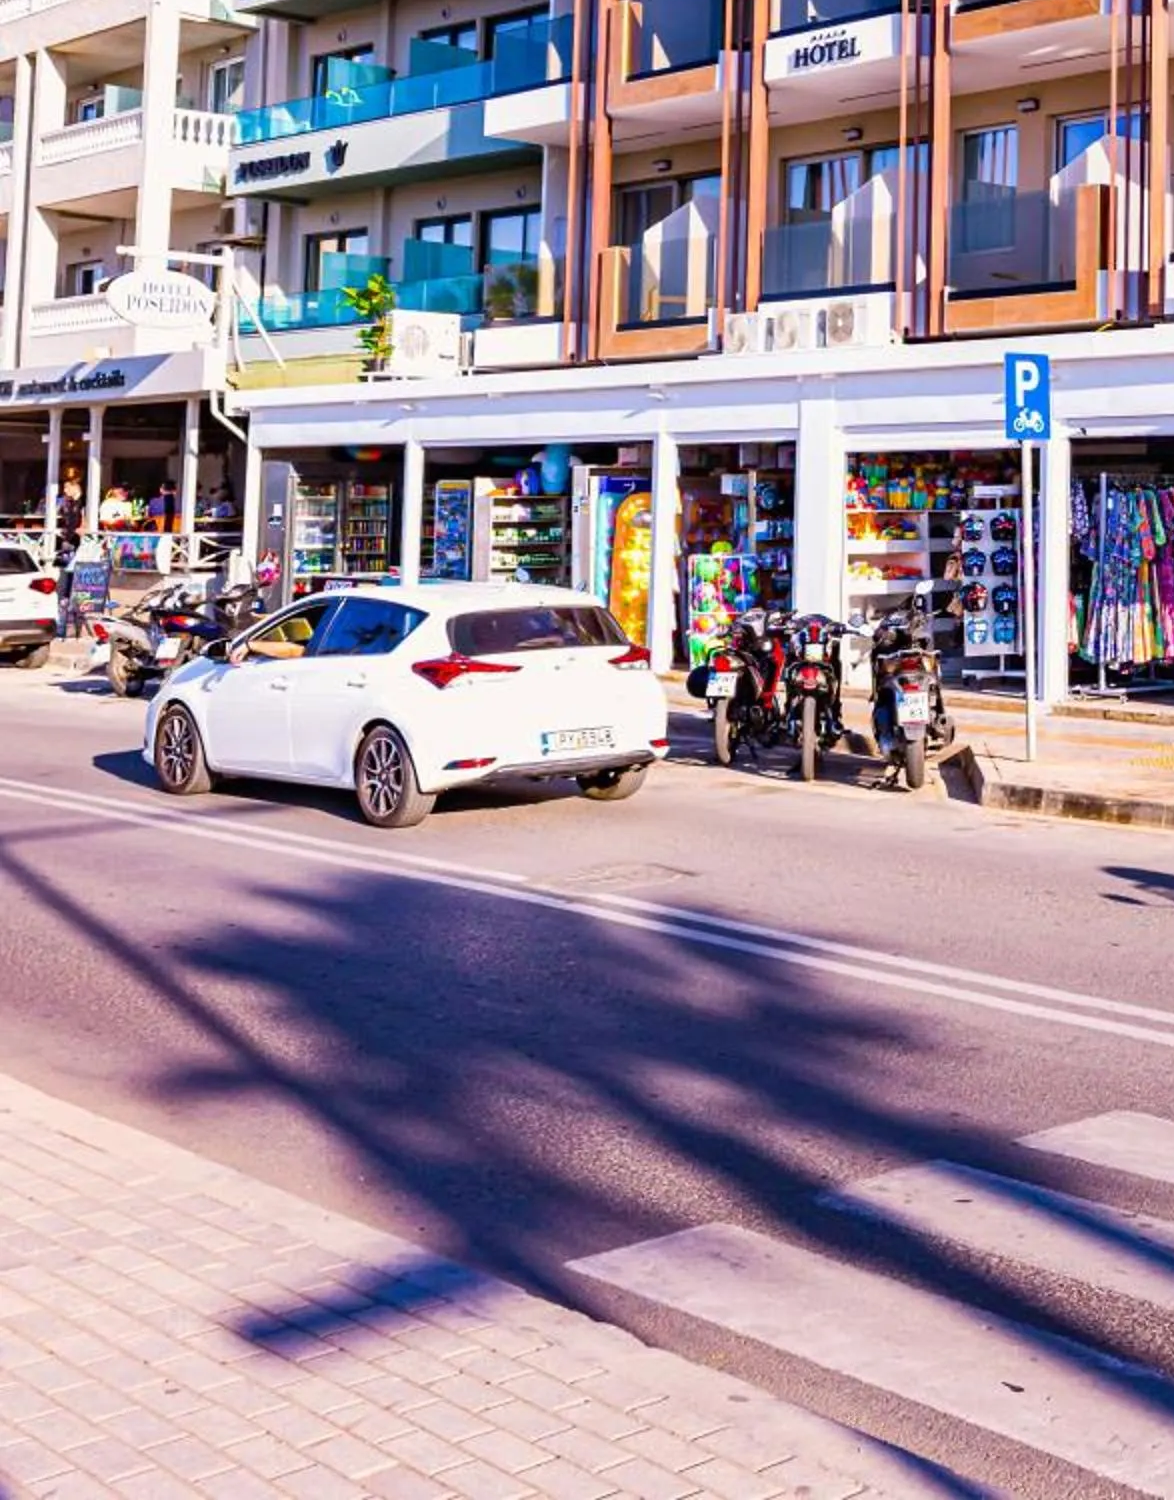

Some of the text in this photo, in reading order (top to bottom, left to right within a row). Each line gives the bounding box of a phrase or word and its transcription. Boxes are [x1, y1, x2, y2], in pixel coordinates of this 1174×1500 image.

[794, 36, 862, 68] HOTEL
[142, 281, 192, 298] HOTEL
[126, 293, 208, 315] POSEIDON
[1014, 360, 1040, 406] P
